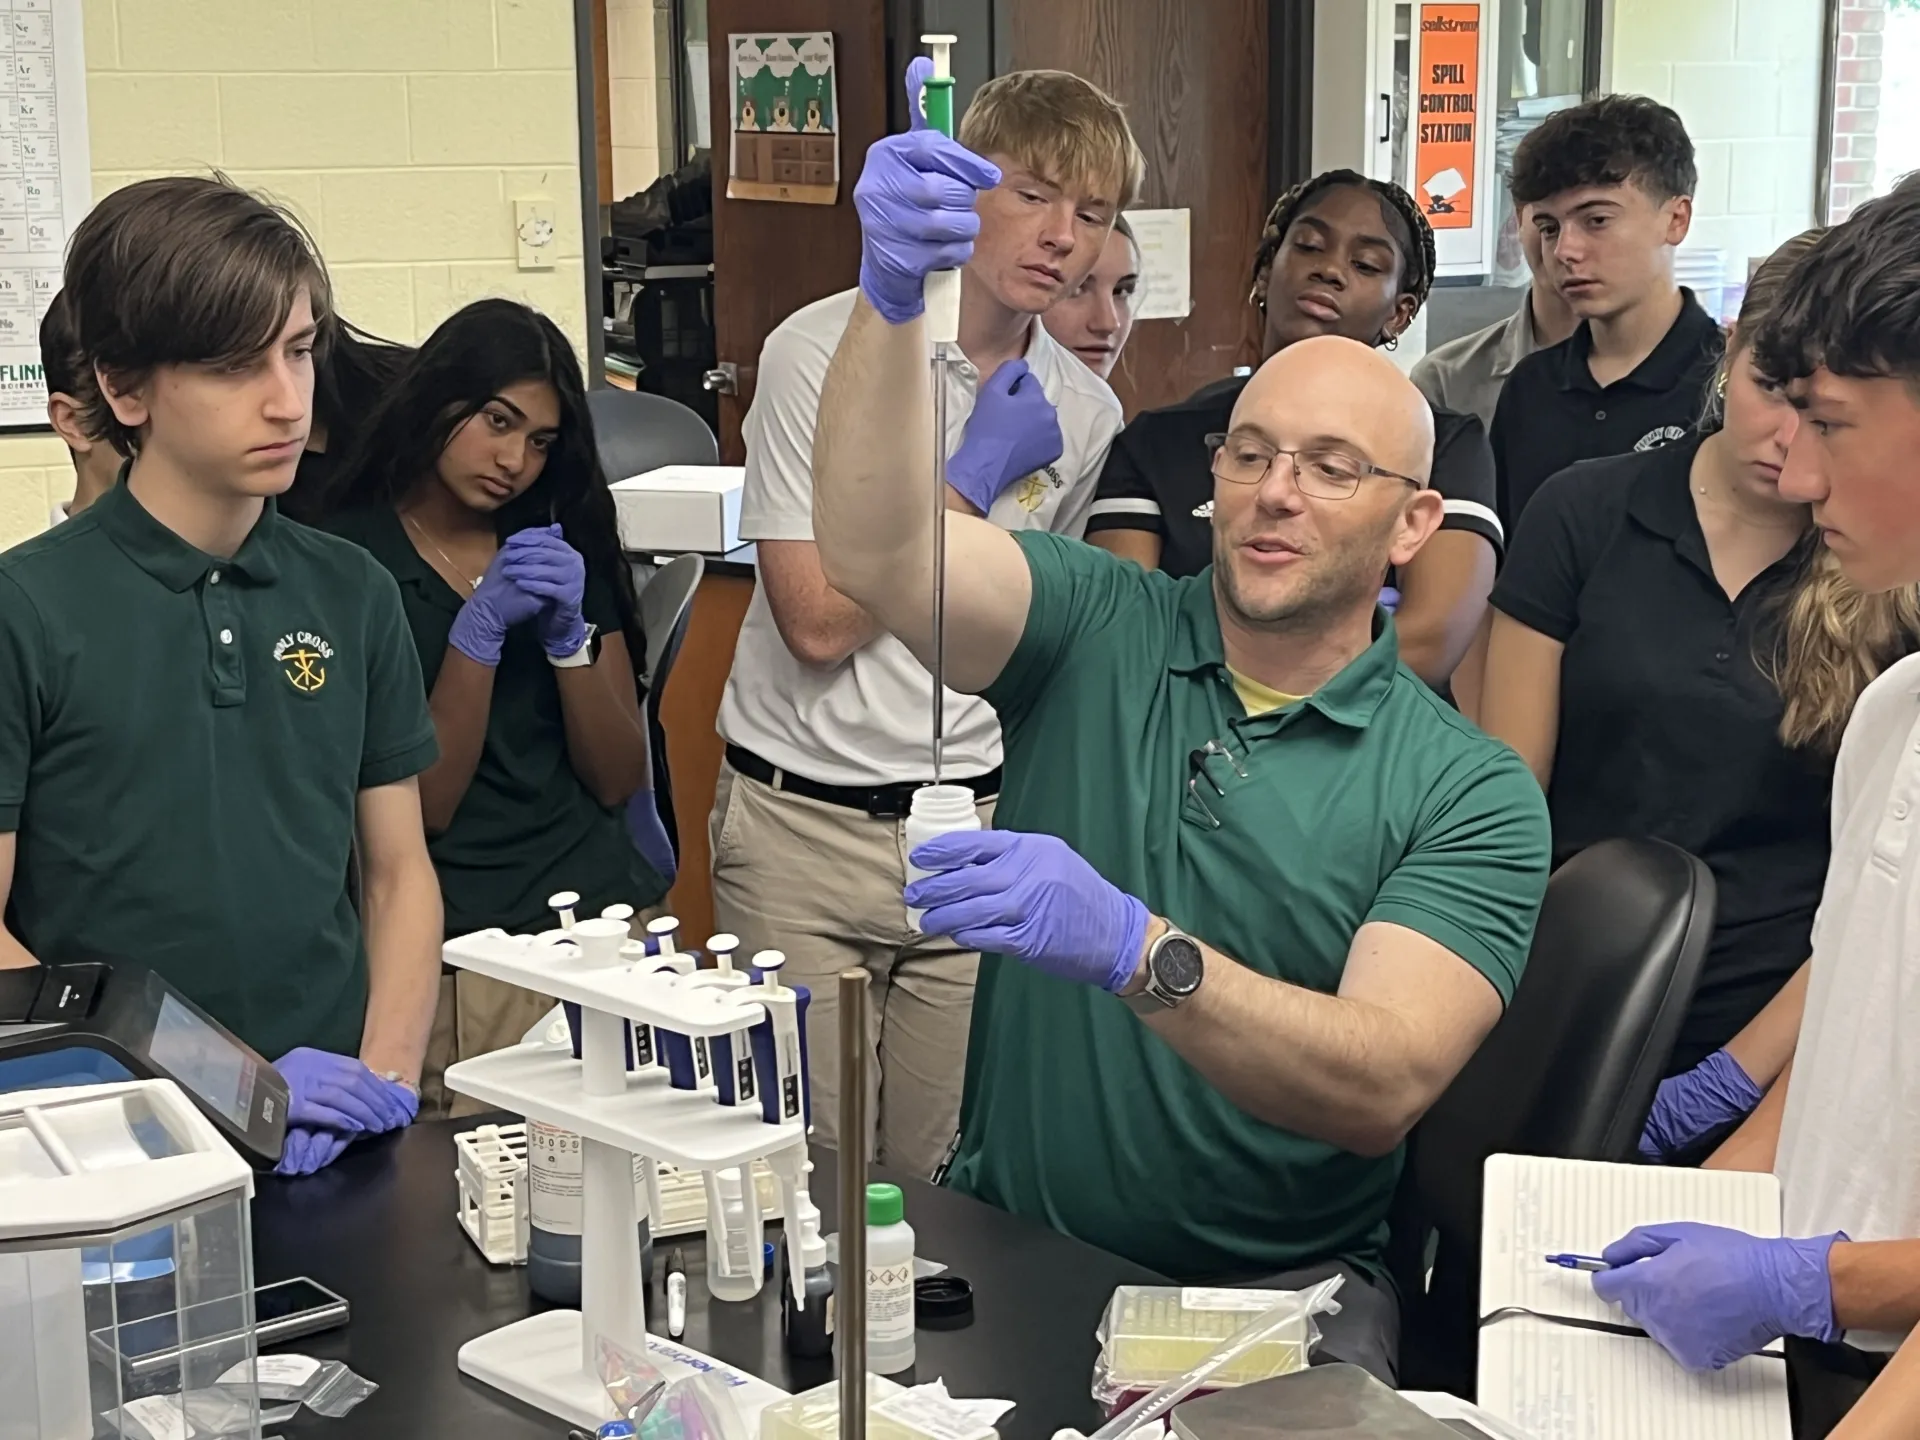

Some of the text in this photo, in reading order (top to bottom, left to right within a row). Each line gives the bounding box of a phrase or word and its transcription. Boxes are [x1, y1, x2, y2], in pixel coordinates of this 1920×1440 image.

[1432, 64, 1465, 84] SPILL
[20, 105, 34, 115] Kr
[1420, 93, 1475, 113] CONTROL
[1420, 123, 1472, 143] STATION
[23, 144, 36, 155] Xe
[27, 186, 41, 196] Rn
[34, 279, 49, 289] Lu
[296, 630, 334, 659] CROSS
